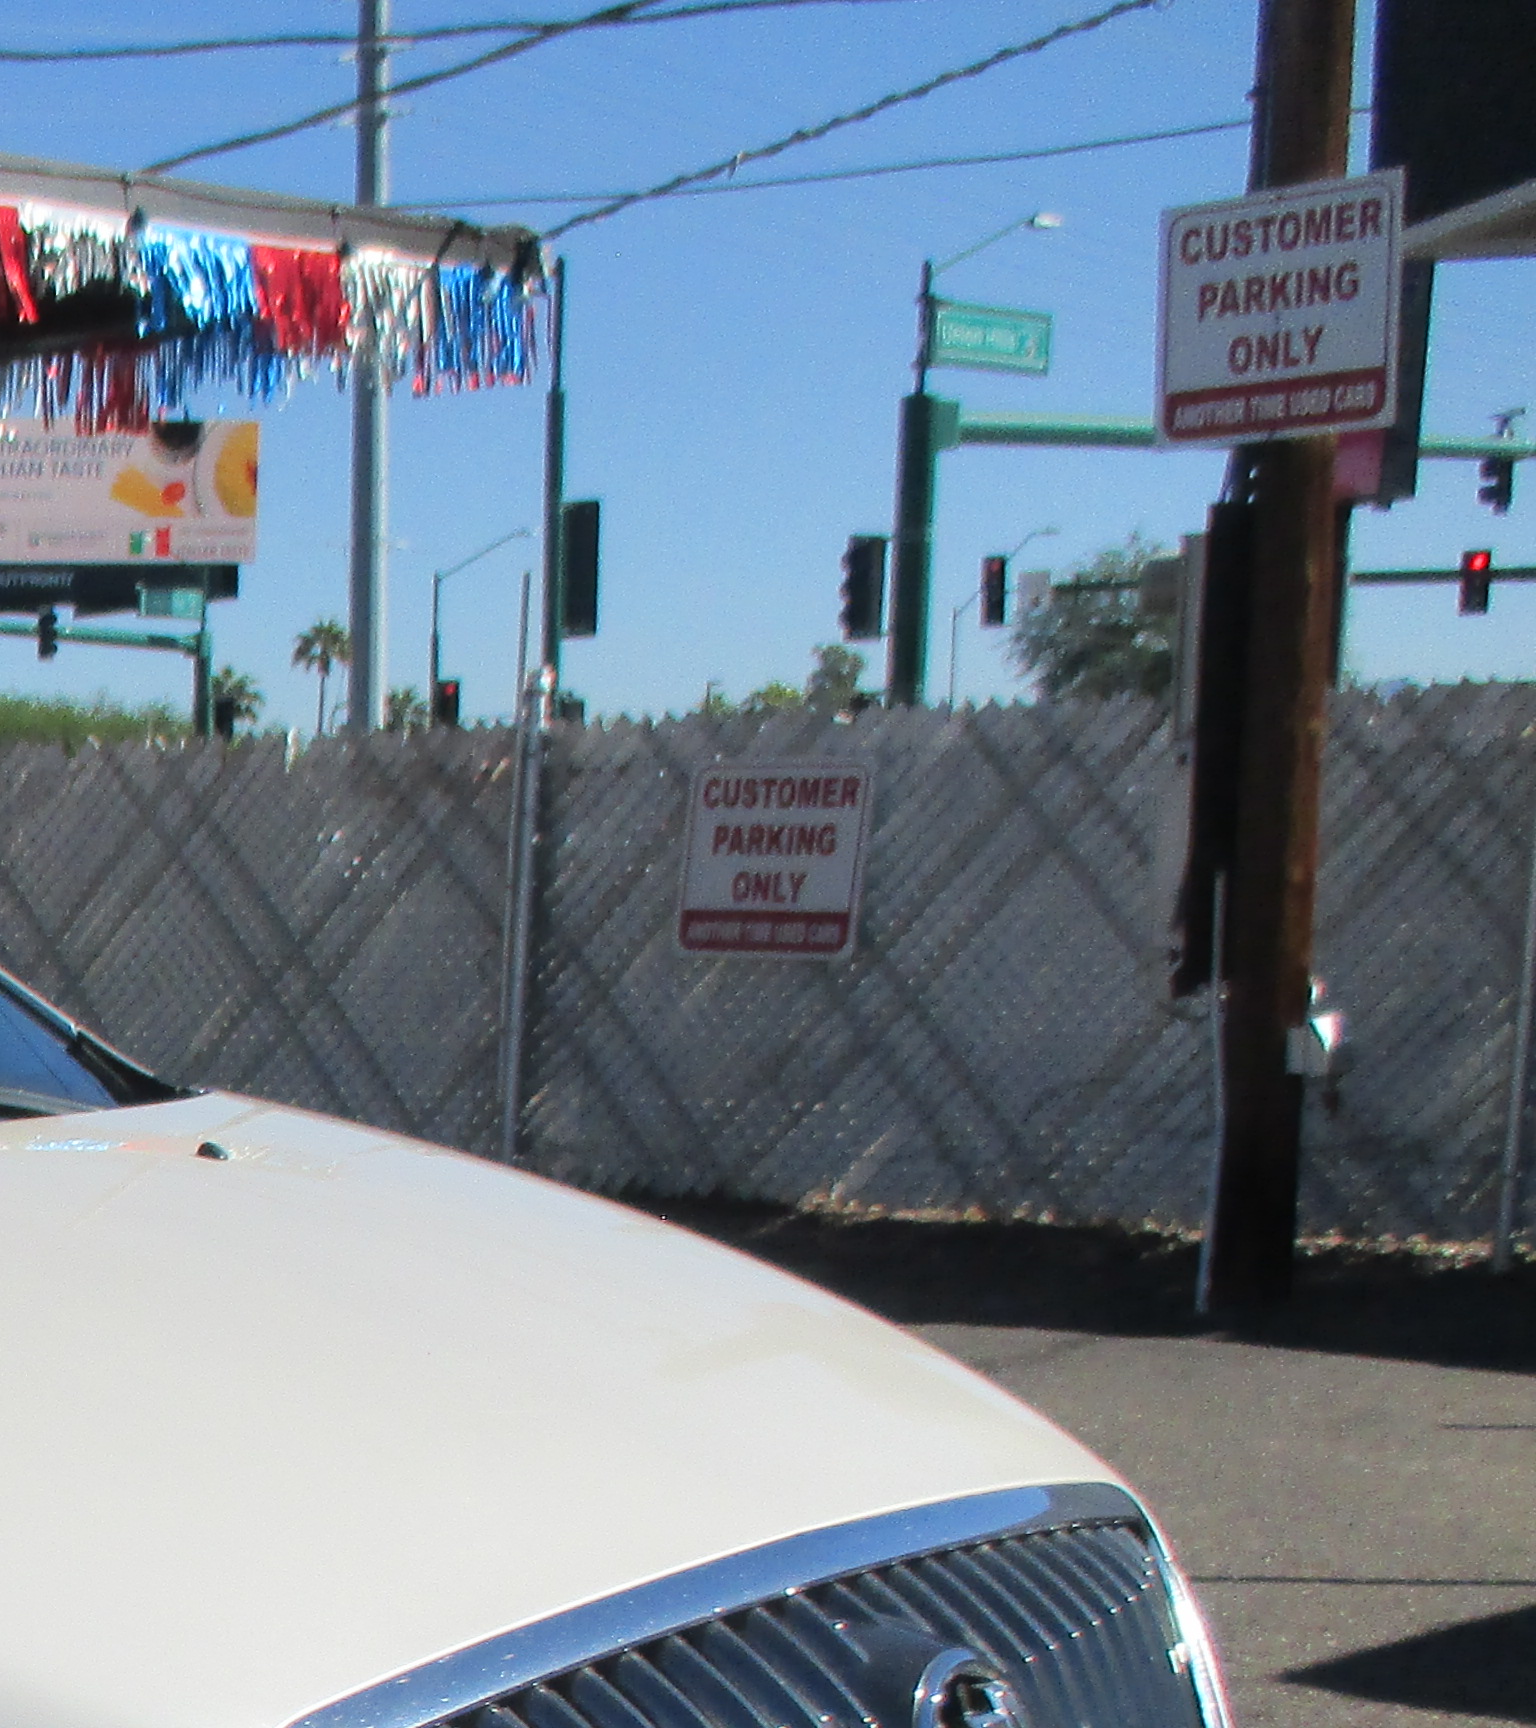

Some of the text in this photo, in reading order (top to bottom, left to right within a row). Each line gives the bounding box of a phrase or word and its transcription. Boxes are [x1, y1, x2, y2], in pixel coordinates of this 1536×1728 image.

[1179, 199, 1381, 266] CUSTOMER
[1196, 262, 1359, 323] PARKING
[1229, 324, 1325, 376] ONLY
[703, 774, 861, 809] CUSTOMER
[711, 822, 837, 857] PARKING
[732, 871, 808, 904] ONLY
